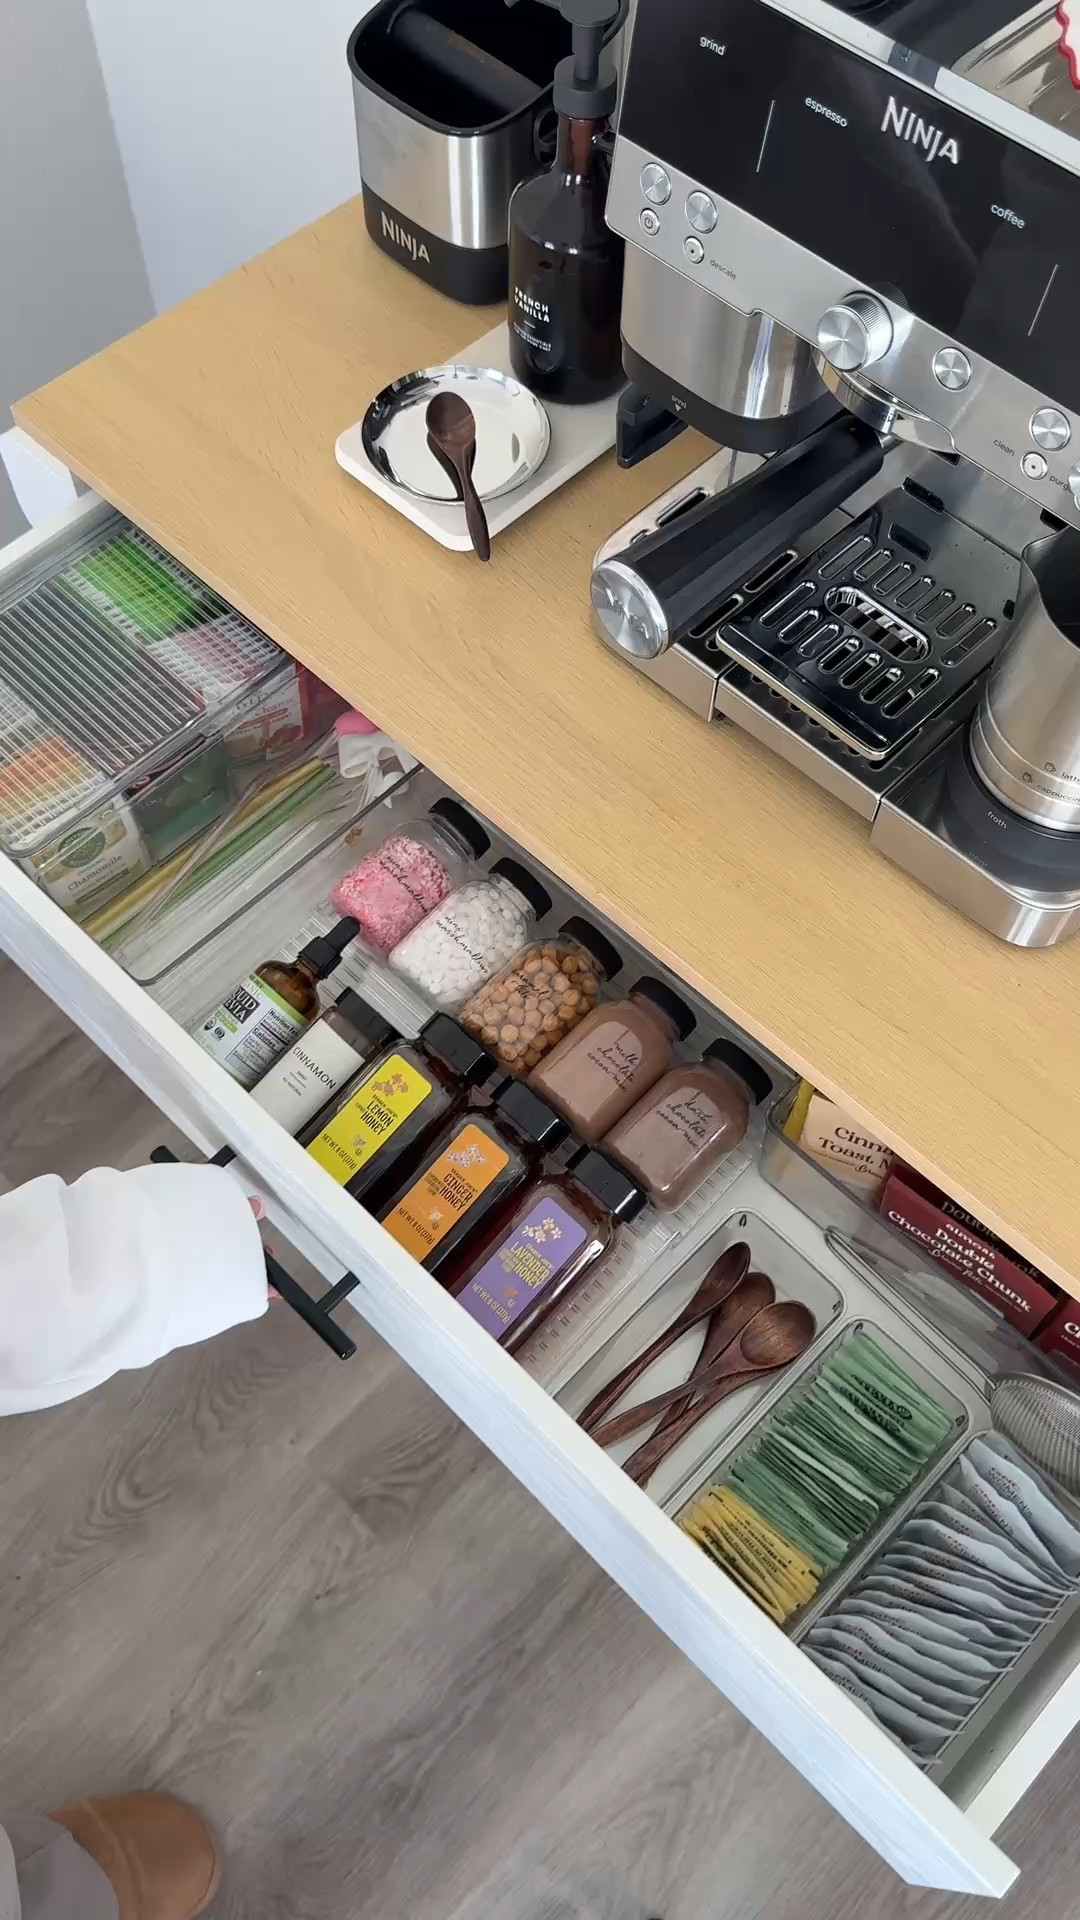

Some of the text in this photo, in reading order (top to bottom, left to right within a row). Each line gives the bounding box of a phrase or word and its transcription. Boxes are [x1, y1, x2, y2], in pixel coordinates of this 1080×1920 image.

[700, 36, 725, 56] grind
[805, 97, 848, 128] espresso
[880, 95, 959, 165] NINJA
[990, 204, 1026, 229] coffee
[381, 210, 431, 264] NINJA
[709, 259, 737, 281] descale
[514, 286, 549, 313] FRENCH
[514, 295, 550, 323] VANILLA
[671, 395, 687, 409] grind
[993, 440, 1015, 457] clean
[987, 811, 1008, 829] froth
[68, 855, 123, 891] Chamomile
[435, 919, 489, 974] marshmallows
[293, 1046, 337, 1090] CINNAMON
[587, 1052, 610, 1073] cocoa
[597, 1046, 635, 1083] chocolate
[360, 1110, 387, 1136] HONEY
[366, 1100, 395, 1128] LEMON
[656, 1109, 680, 1131] cocoa
[665, 1103, 706, 1140] chocolate
[684, 1095, 713, 1125] dark
[818, 1136, 874, 1164] Toast
[439, 1185, 467, 1212] HONEY
[443, 1173, 474, 1203] GINGER
[510, 1241, 550, 1281] LAVENDER
[887, 1210, 974, 1269] Chocolate
[976, 1266, 1033, 1313] Chunk
[935, 1227, 995, 1271] Double
[513, 1261, 543, 1289] HONEY
